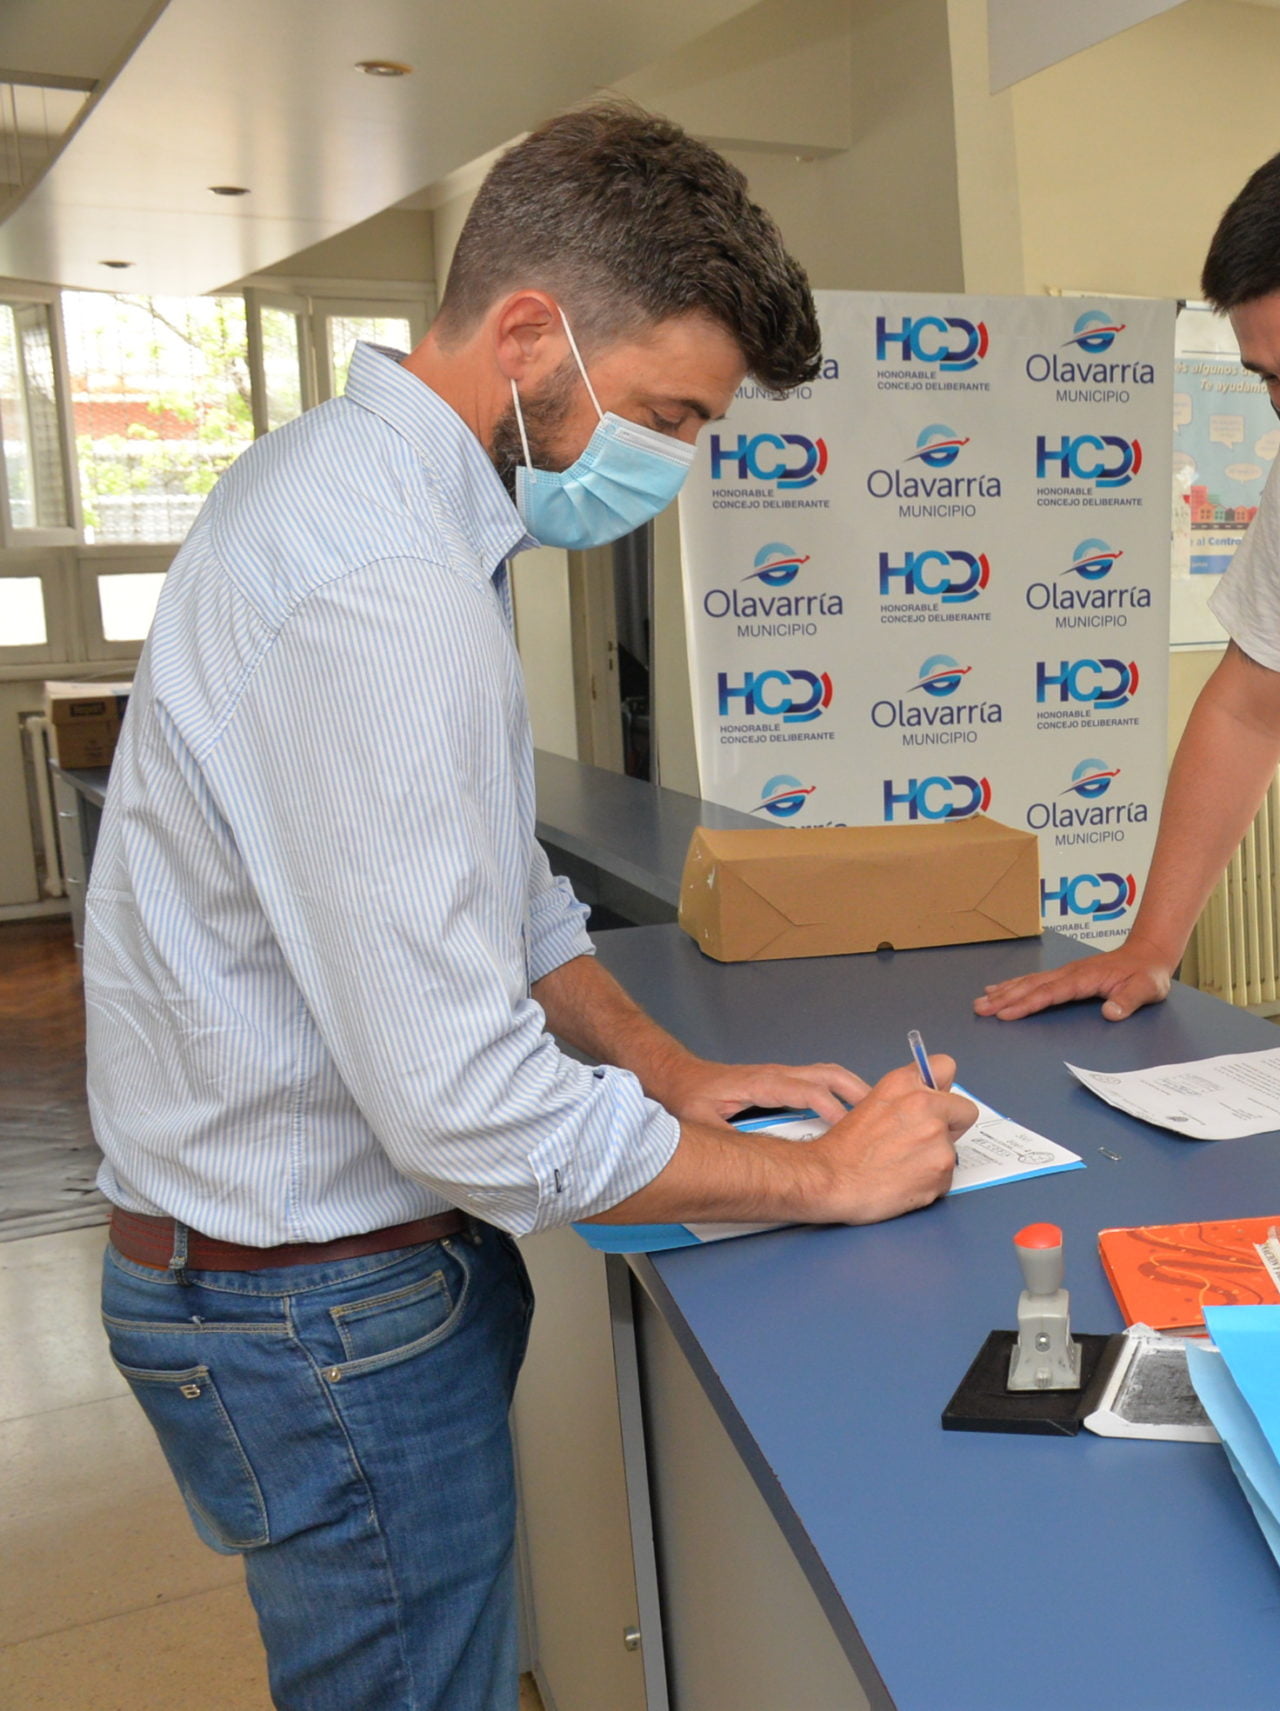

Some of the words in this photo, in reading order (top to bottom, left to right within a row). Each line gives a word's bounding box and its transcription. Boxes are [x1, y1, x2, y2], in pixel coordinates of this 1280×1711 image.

[877, 316, 990, 372] HCD
[877, 371, 936, 379] HONORABLE
[1026, 354, 1154, 384] Olavarría
[877, 382, 921, 390] CONCEJO
[924, 382, 990, 391] DELIBERANTE
[1216, 381, 1270, 395] ayudamo
[1056, 389, 1130, 403] MUNICIPIO
[711, 433, 828, 489] HCD
[1036, 435, 1142, 487] HCD
[867, 469, 1001, 499] Olavarría
[713, 489, 773, 498] HONORABLE
[1037, 488, 1092, 496] HONORABLE
[713, 500, 759, 509] CONCEJO
[762, 500, 829, 509] DELIBERANTE
[1037, 498, 1078, 506] CONCEJO
[1081, 498, 1142, 506] DELIBERANTE
[899, 504, 976, 518] MUNICIPIO
[879, 550, 990, 603] HCD
[704, 588, 843, 618] Olavarría
[1026, 582, 1151, 611] Olavarría
[881, 603, 938, 613] HONORABLE
[881, 615, 925, 623] CONCEJO
[928, 613, 991, 622] DELIBERANTE
[1055, 614, 1127, 628] MUNICIPIO
[737, 623, 817, 637] MUNICIPIO
[1036, 659, 1139, 710] HCD
[718, 670, 832, 723] HCD
[871, 700, 1002, 729] Olavarría
[1037, 710, 1091, 720] HONORABLE
[720, 723, 780, 733] HONORABLE
[1037, 720, 1078, 730] CONCEJO
[1081, 718, 1139, 728] DELIBERANTE
[720, 735, 767, 744] CONCEJO
[770, 732, 835, 742] DELIBERANTE
[903, 731, 978, 746] MUNICIPIO
[1026, 802, 1148, 829] Olavarría
[1055, 830, 1125, 846] MUNICIPIO
